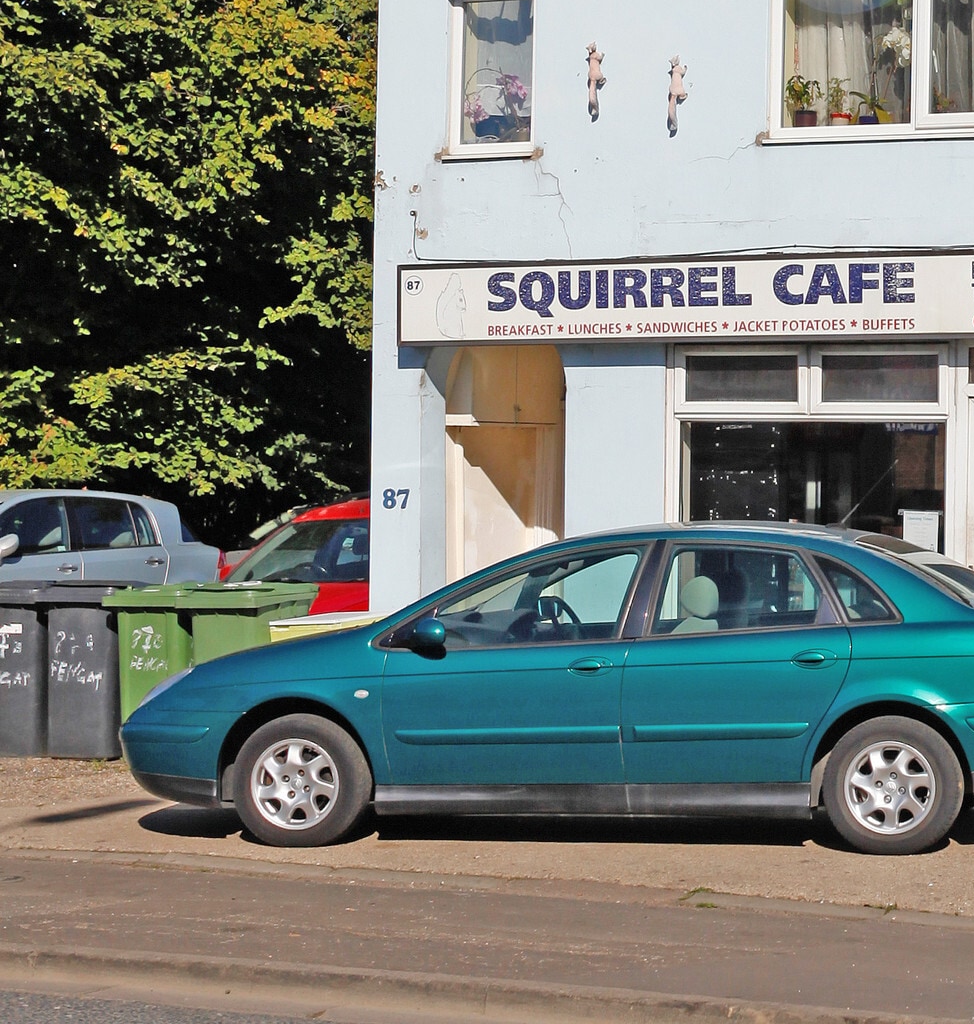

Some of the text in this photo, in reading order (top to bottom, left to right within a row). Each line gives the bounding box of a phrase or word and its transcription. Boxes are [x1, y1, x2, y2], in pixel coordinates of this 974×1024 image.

[406, 280, 420, 291] 87
[487, 262, 916, 317] SQUIRREL CAFE
[487, 318, 915, 336] BREAKFAST LUNCHES SANDWICHES JACKET POTATOES BUFFETS
[382, 488, 410, 510] 87
